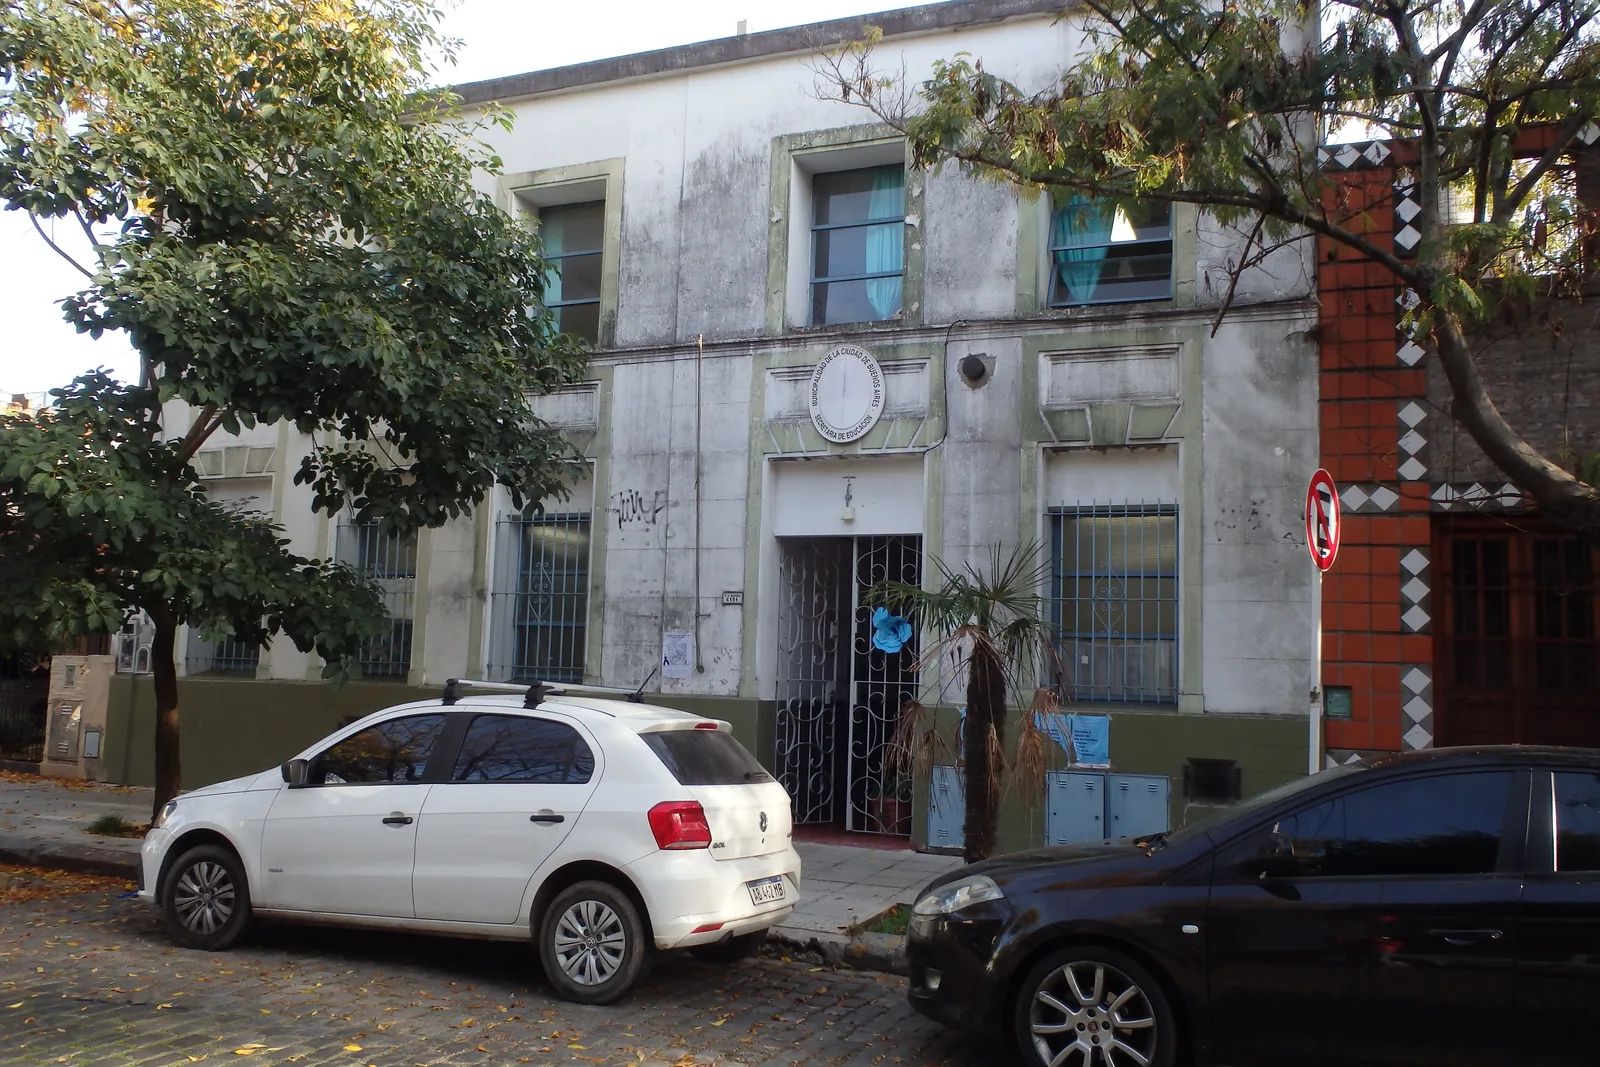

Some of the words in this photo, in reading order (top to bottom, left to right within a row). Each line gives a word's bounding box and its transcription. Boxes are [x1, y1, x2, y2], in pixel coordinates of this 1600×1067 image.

[824, 354, 834, 363] DE
[832, 349, 840, 358] LA
[840, 348, 863, 359] CIUDAD
[861, 355, 871, 365] DE
[812, 362, 827, 407] MUNICIPALIDAD
[867, 363, 881, 388] BUENOS
[871, 389, 880, 408] AIRES
[814, 414, 837, 439] SECRETARIA
[837, 432, 845, 440] DE
[846, 414, 873, 439] EDUCACION
[752, 887, 763, 901] AB
[773, 883, 784, 896] MB
